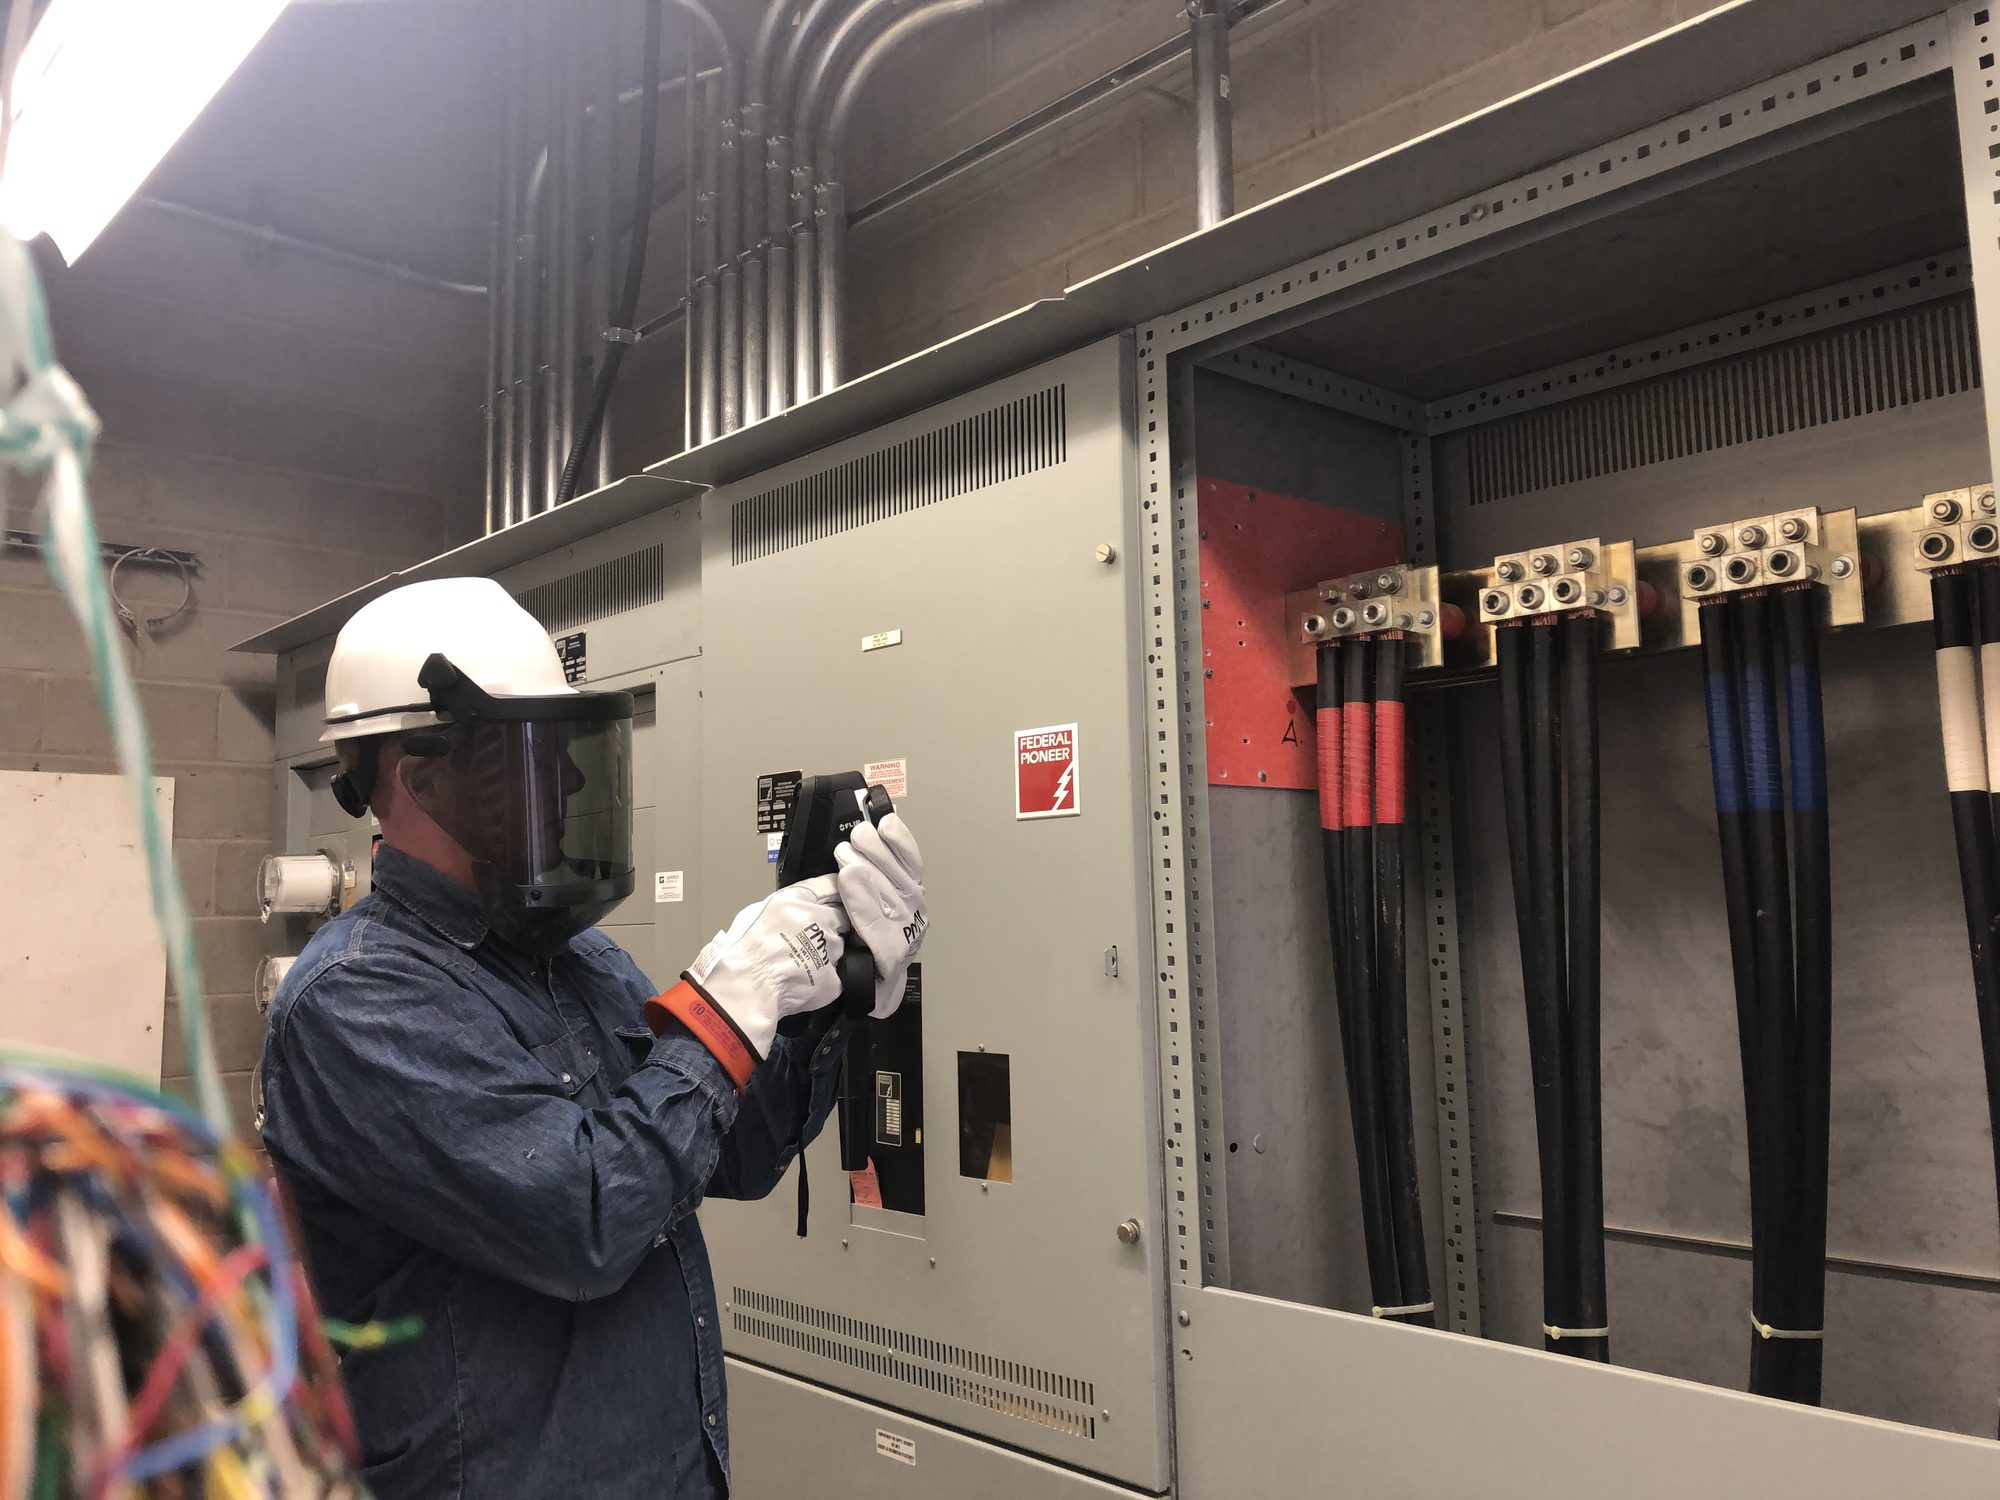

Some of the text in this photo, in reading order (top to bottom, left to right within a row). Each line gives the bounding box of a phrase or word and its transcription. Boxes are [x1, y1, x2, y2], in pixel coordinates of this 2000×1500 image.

[1020, 732, 1072, 750] FEDERAL
[1020, 747, 1070, 765] PIONEER
[869, 762, 901, 771] WARNING
[797, 931, 823, 970] INTERNATIONAL
[803, 923, 830, 966] PMMI
[693, 1003, 706, 1016] 10
